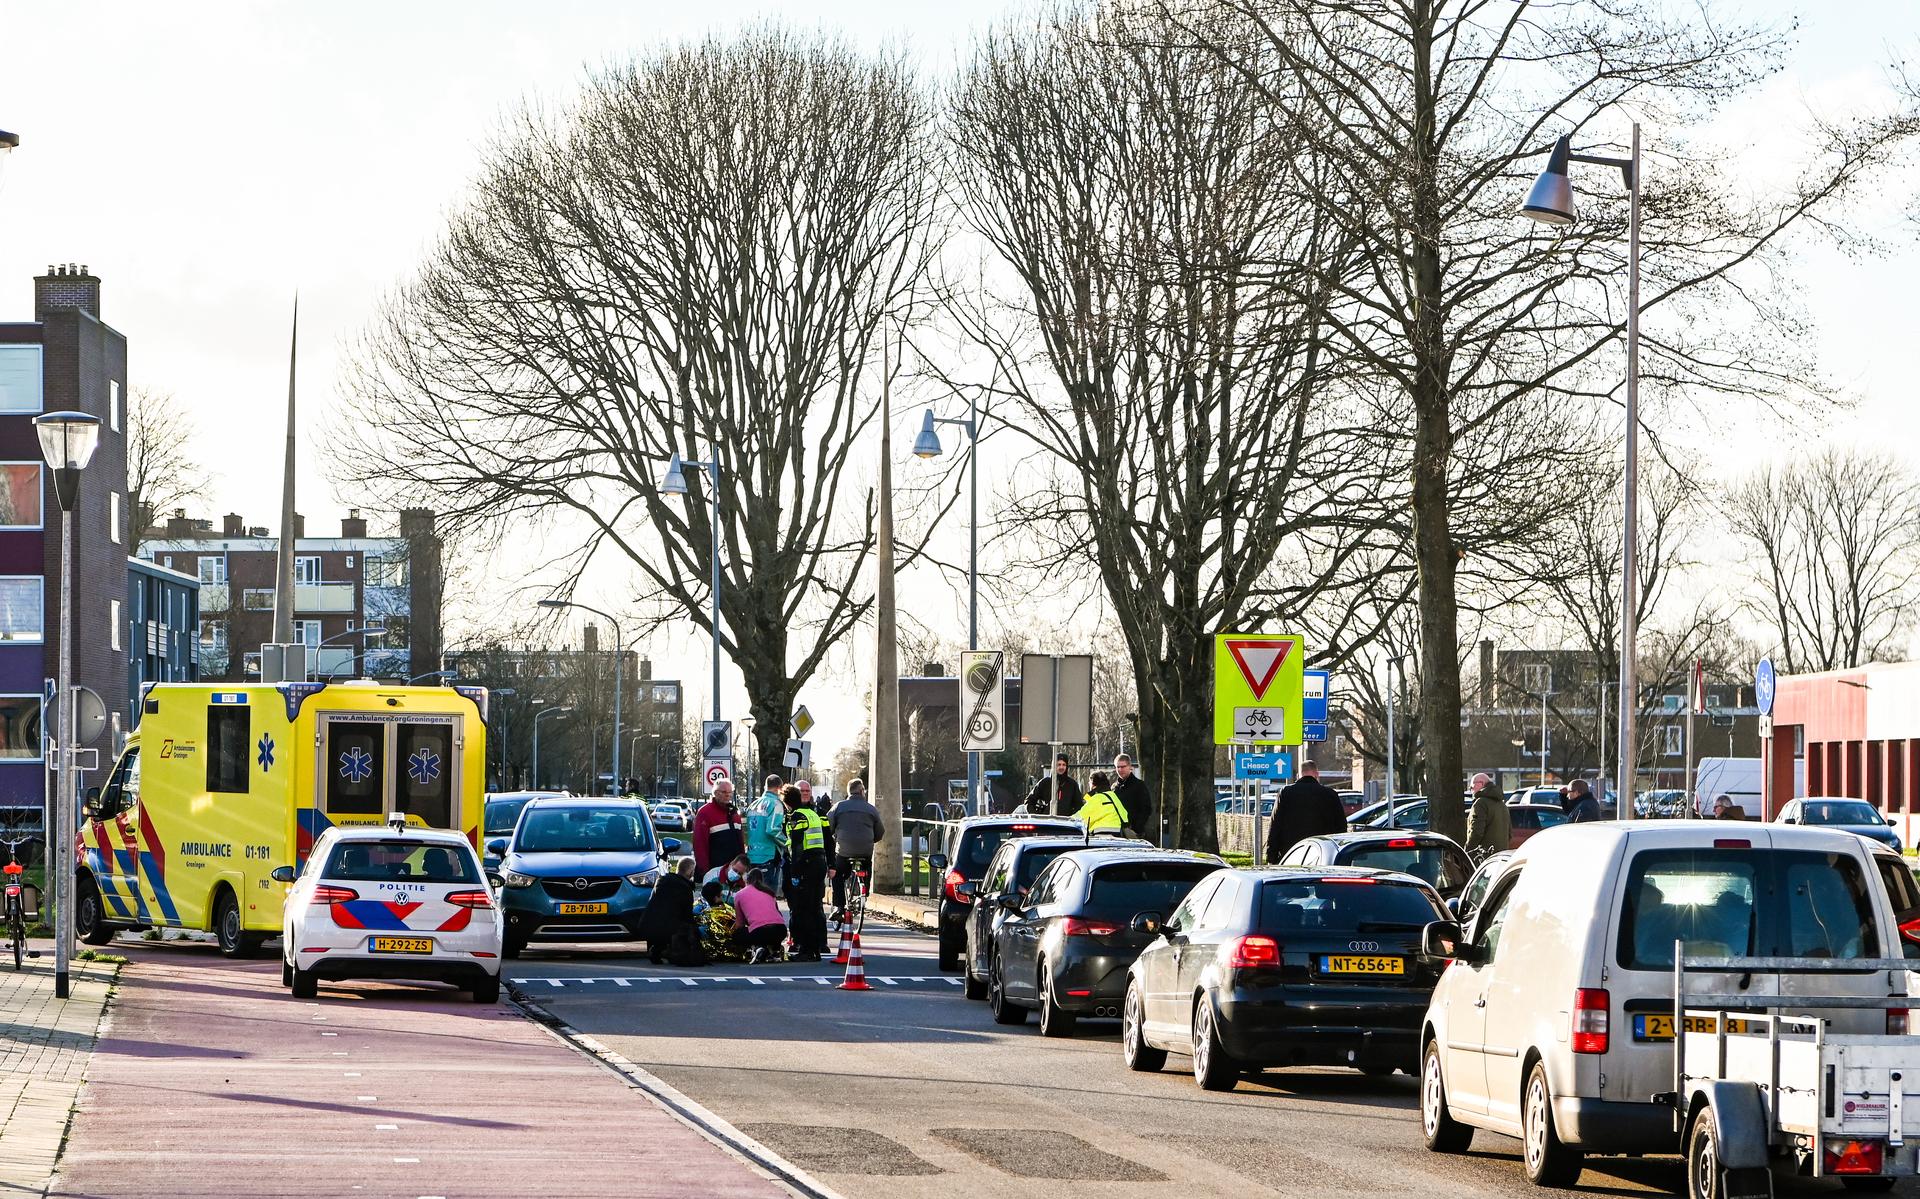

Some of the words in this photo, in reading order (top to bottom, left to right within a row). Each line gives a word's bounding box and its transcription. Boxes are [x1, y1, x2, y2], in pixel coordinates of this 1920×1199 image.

[973, 720, 993, 732] 30
[711, 772, 725, 781] 30
[180, 842, 232, 857] AMBULANCE
[245, 845, 270, 860] 01-181
[186, 861, 206, 870] Groningen
[380, 883, 425, 892] POLITIE
[565, 904, 602, 913] ZB-718-J
[379, 939, 428, 950] H-292-ZS
[1333, 958, 1399, 972] NT-656-F
